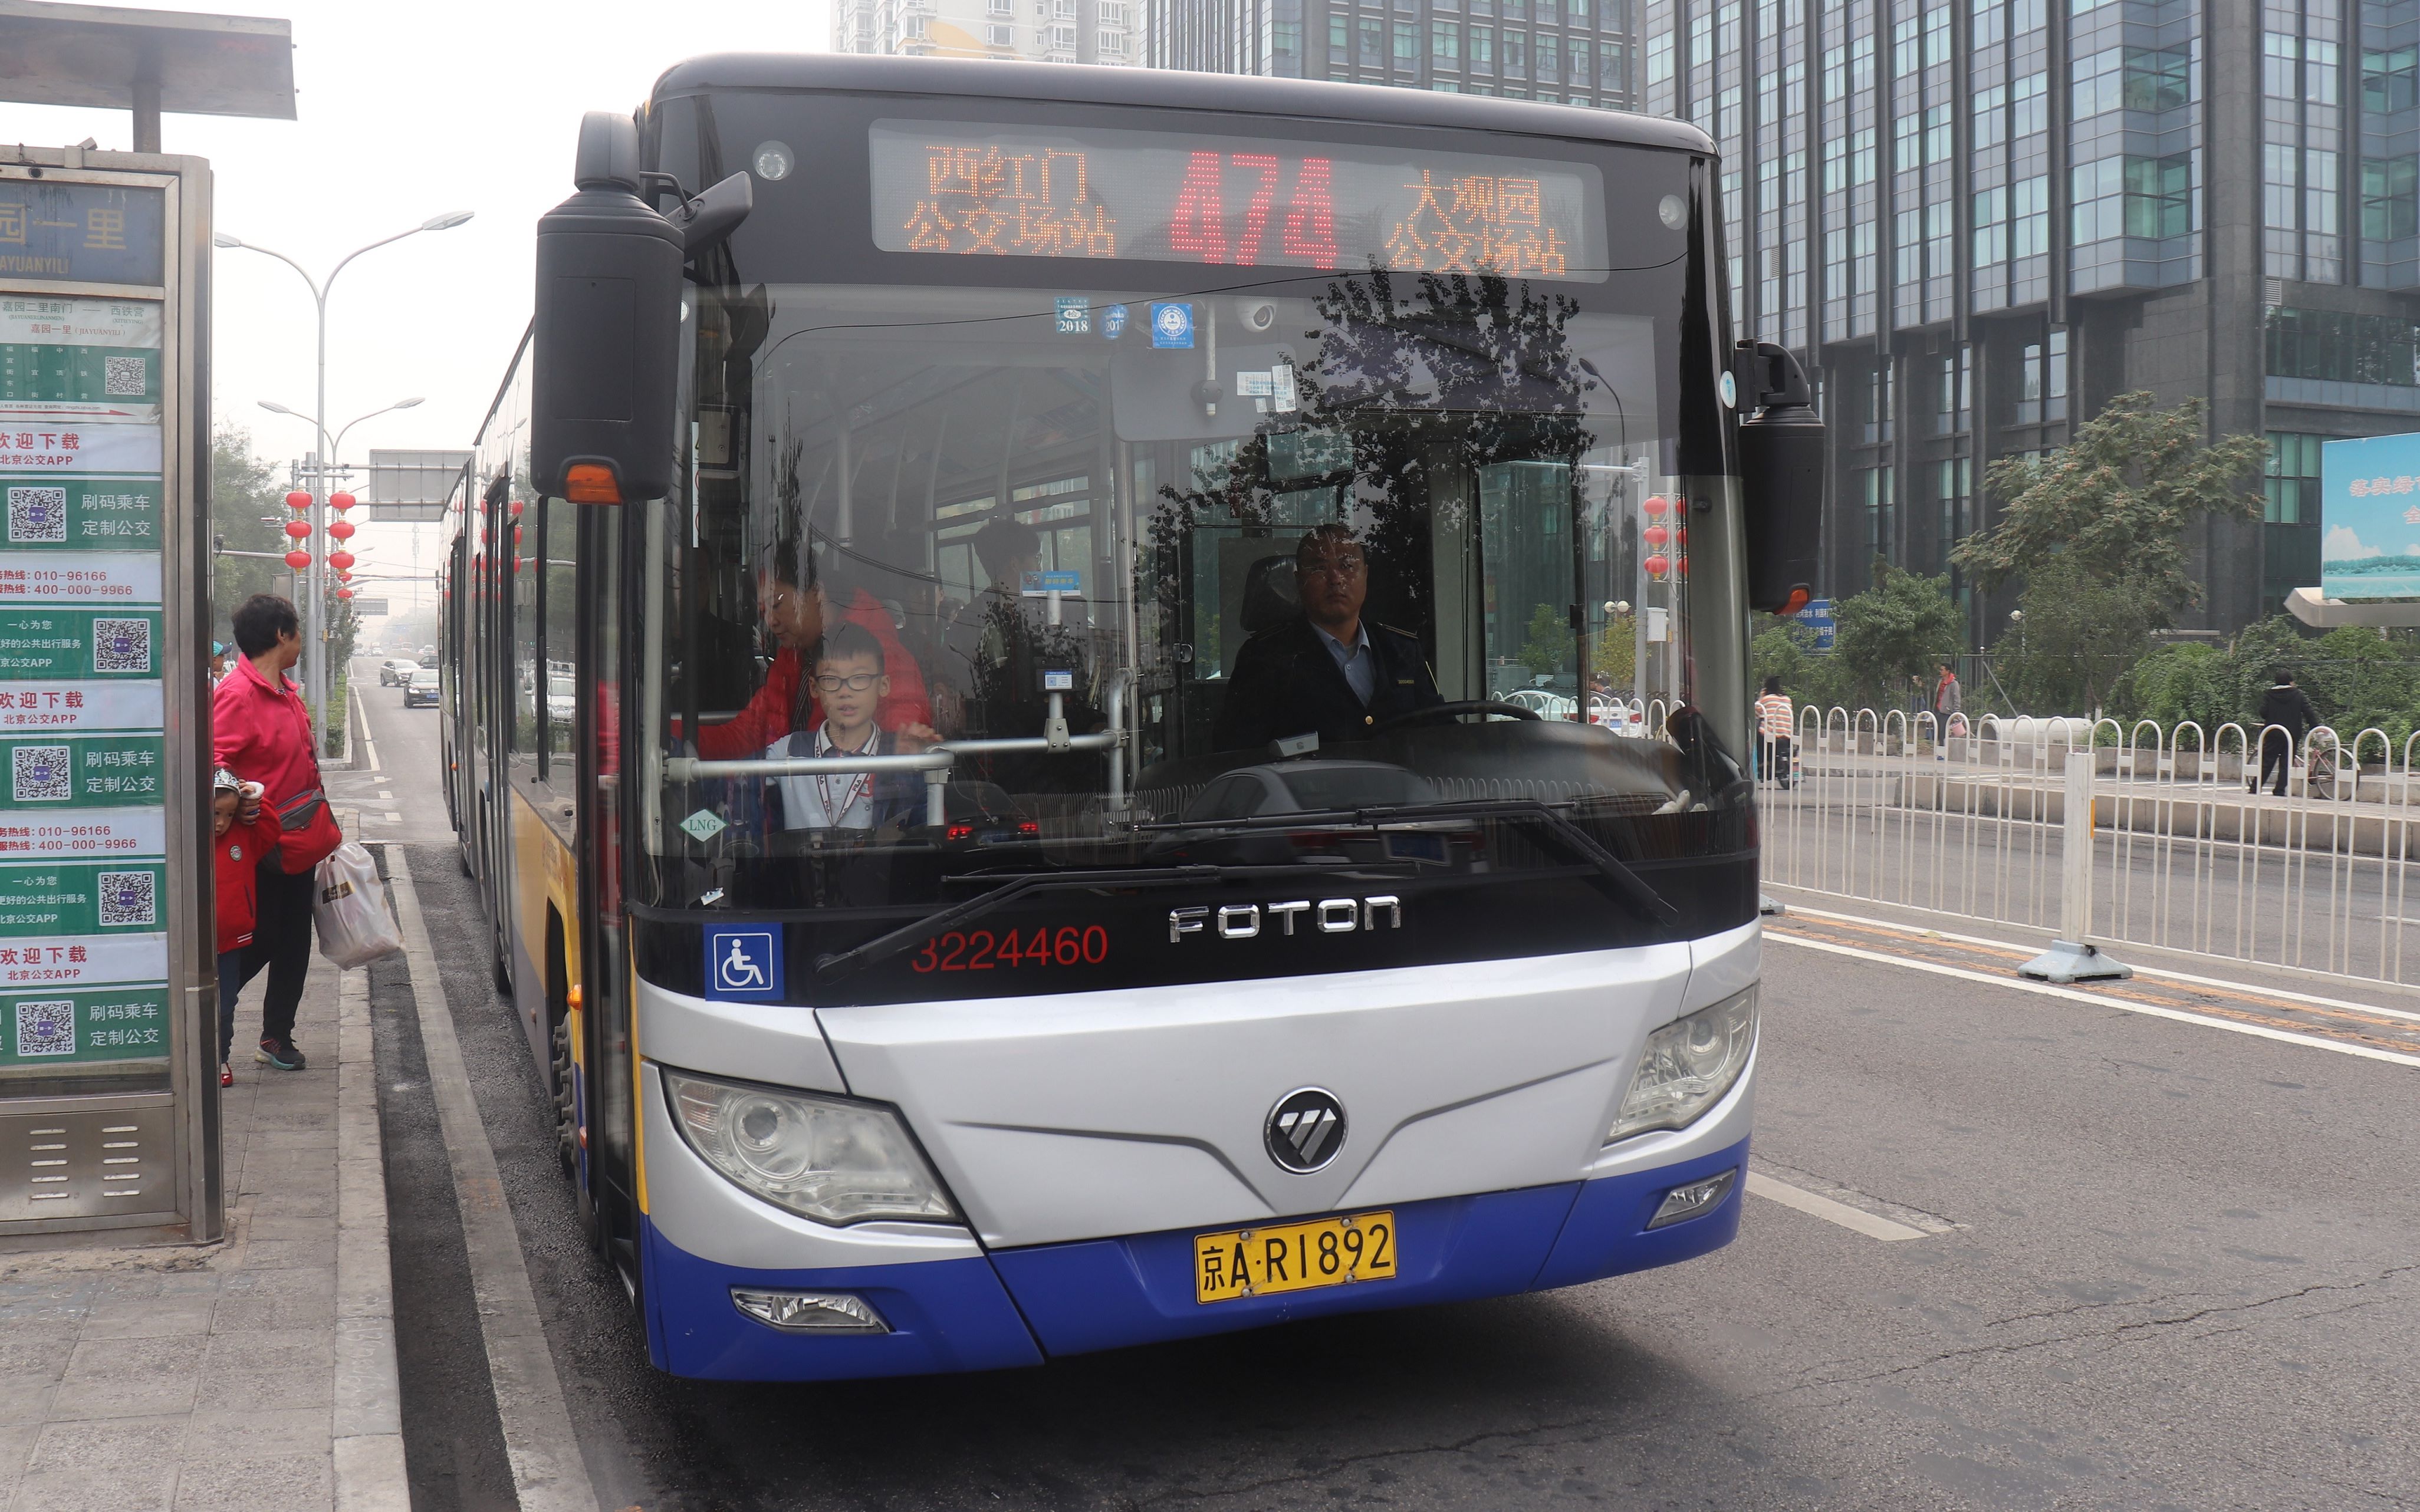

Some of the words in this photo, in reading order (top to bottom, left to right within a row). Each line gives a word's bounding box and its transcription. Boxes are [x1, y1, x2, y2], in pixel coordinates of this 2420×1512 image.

[925, 146, 1085, 204] 西红门
[1403, 168, 1540, 226] 大观园
[1172, 151, 1337, 269] 474
[905, 201, 1116, 256] 公交场站
[1386, 222, 1567, 275] 公交场站
[2, 301, 73, 313] 嘉园二里南门
[111, 305, 144, 317] 西铁营
[31, 324, 71, 334] 嘉园一里
[1060, 320, 1088, 331] 2018
[1106, 320, 1124, 331] 2017
[1, 455, 73, 465] 北京公交APP
[81, 494, 150, 511] 刷码乘车
[81, 519, 151, 536] 定制公交
[7, 620, 52, 630] 一心为您
[0, 638, 81, 649] 好的公共出行服务
[0, 691, 84, 709] 欢迎下载
[4, 714, 77, 724] 北京公交APP
[86, 750, 154, 767] 刷码乘车
[86, 776, 155, 793] 定制公交
[852, 779, 862, 792] FILA
[689, 819, 716, 831] LNG
[12, 876, 57, 886] 一心为您
[1169, 895, 1401, 943] FOTON
[0, 946, 87, 966] 欢迎下载
[911, 924, 1109, 973] 3224460
[8, 969, 81, 980] 北京公交APP
[89, 1002, 159, 1022] 刷码乘车
[90, 1028, 159, 1046] 定制公交
